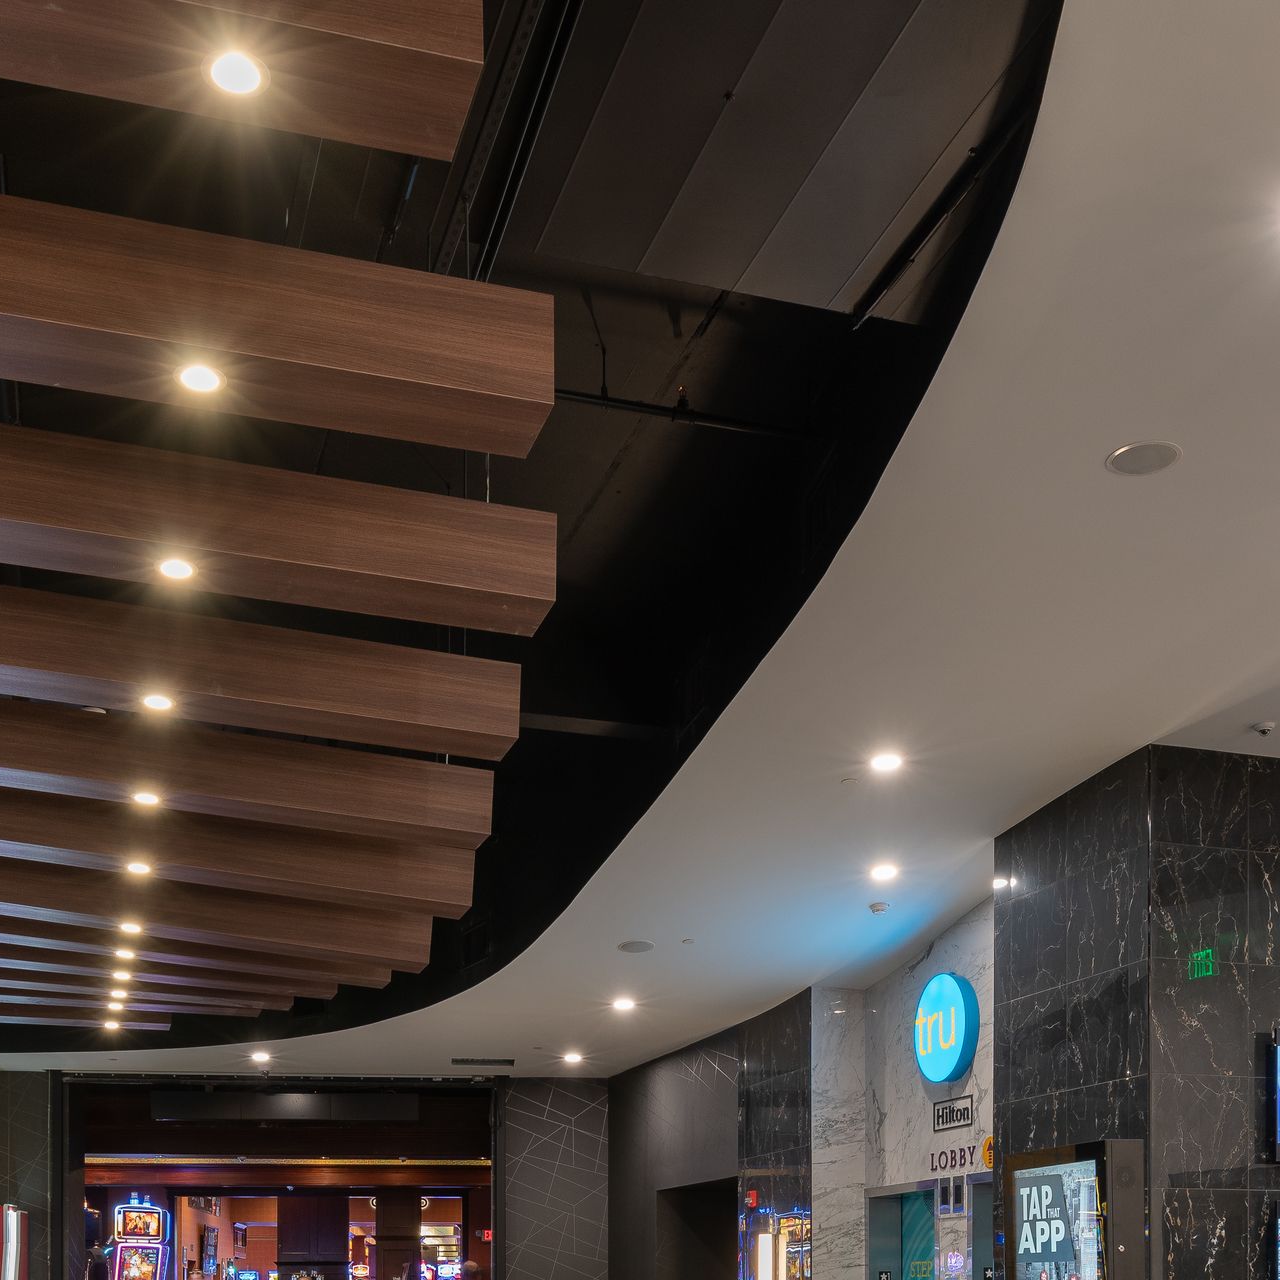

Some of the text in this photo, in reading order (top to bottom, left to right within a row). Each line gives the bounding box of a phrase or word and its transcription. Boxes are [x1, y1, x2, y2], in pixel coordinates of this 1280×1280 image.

[915, 1006, 956, 1056] tru
[936, 1102, 970, 1126] Hilton
[930, 1145, 976, 1172] LOBBY
[1020, 1185, 1053, 1221] TAP
[1047, 1208, 1060, 1219] THAT
[1018, 1220, 1066, 1254] APP
[911, 1261, 933, 1278] STEP
